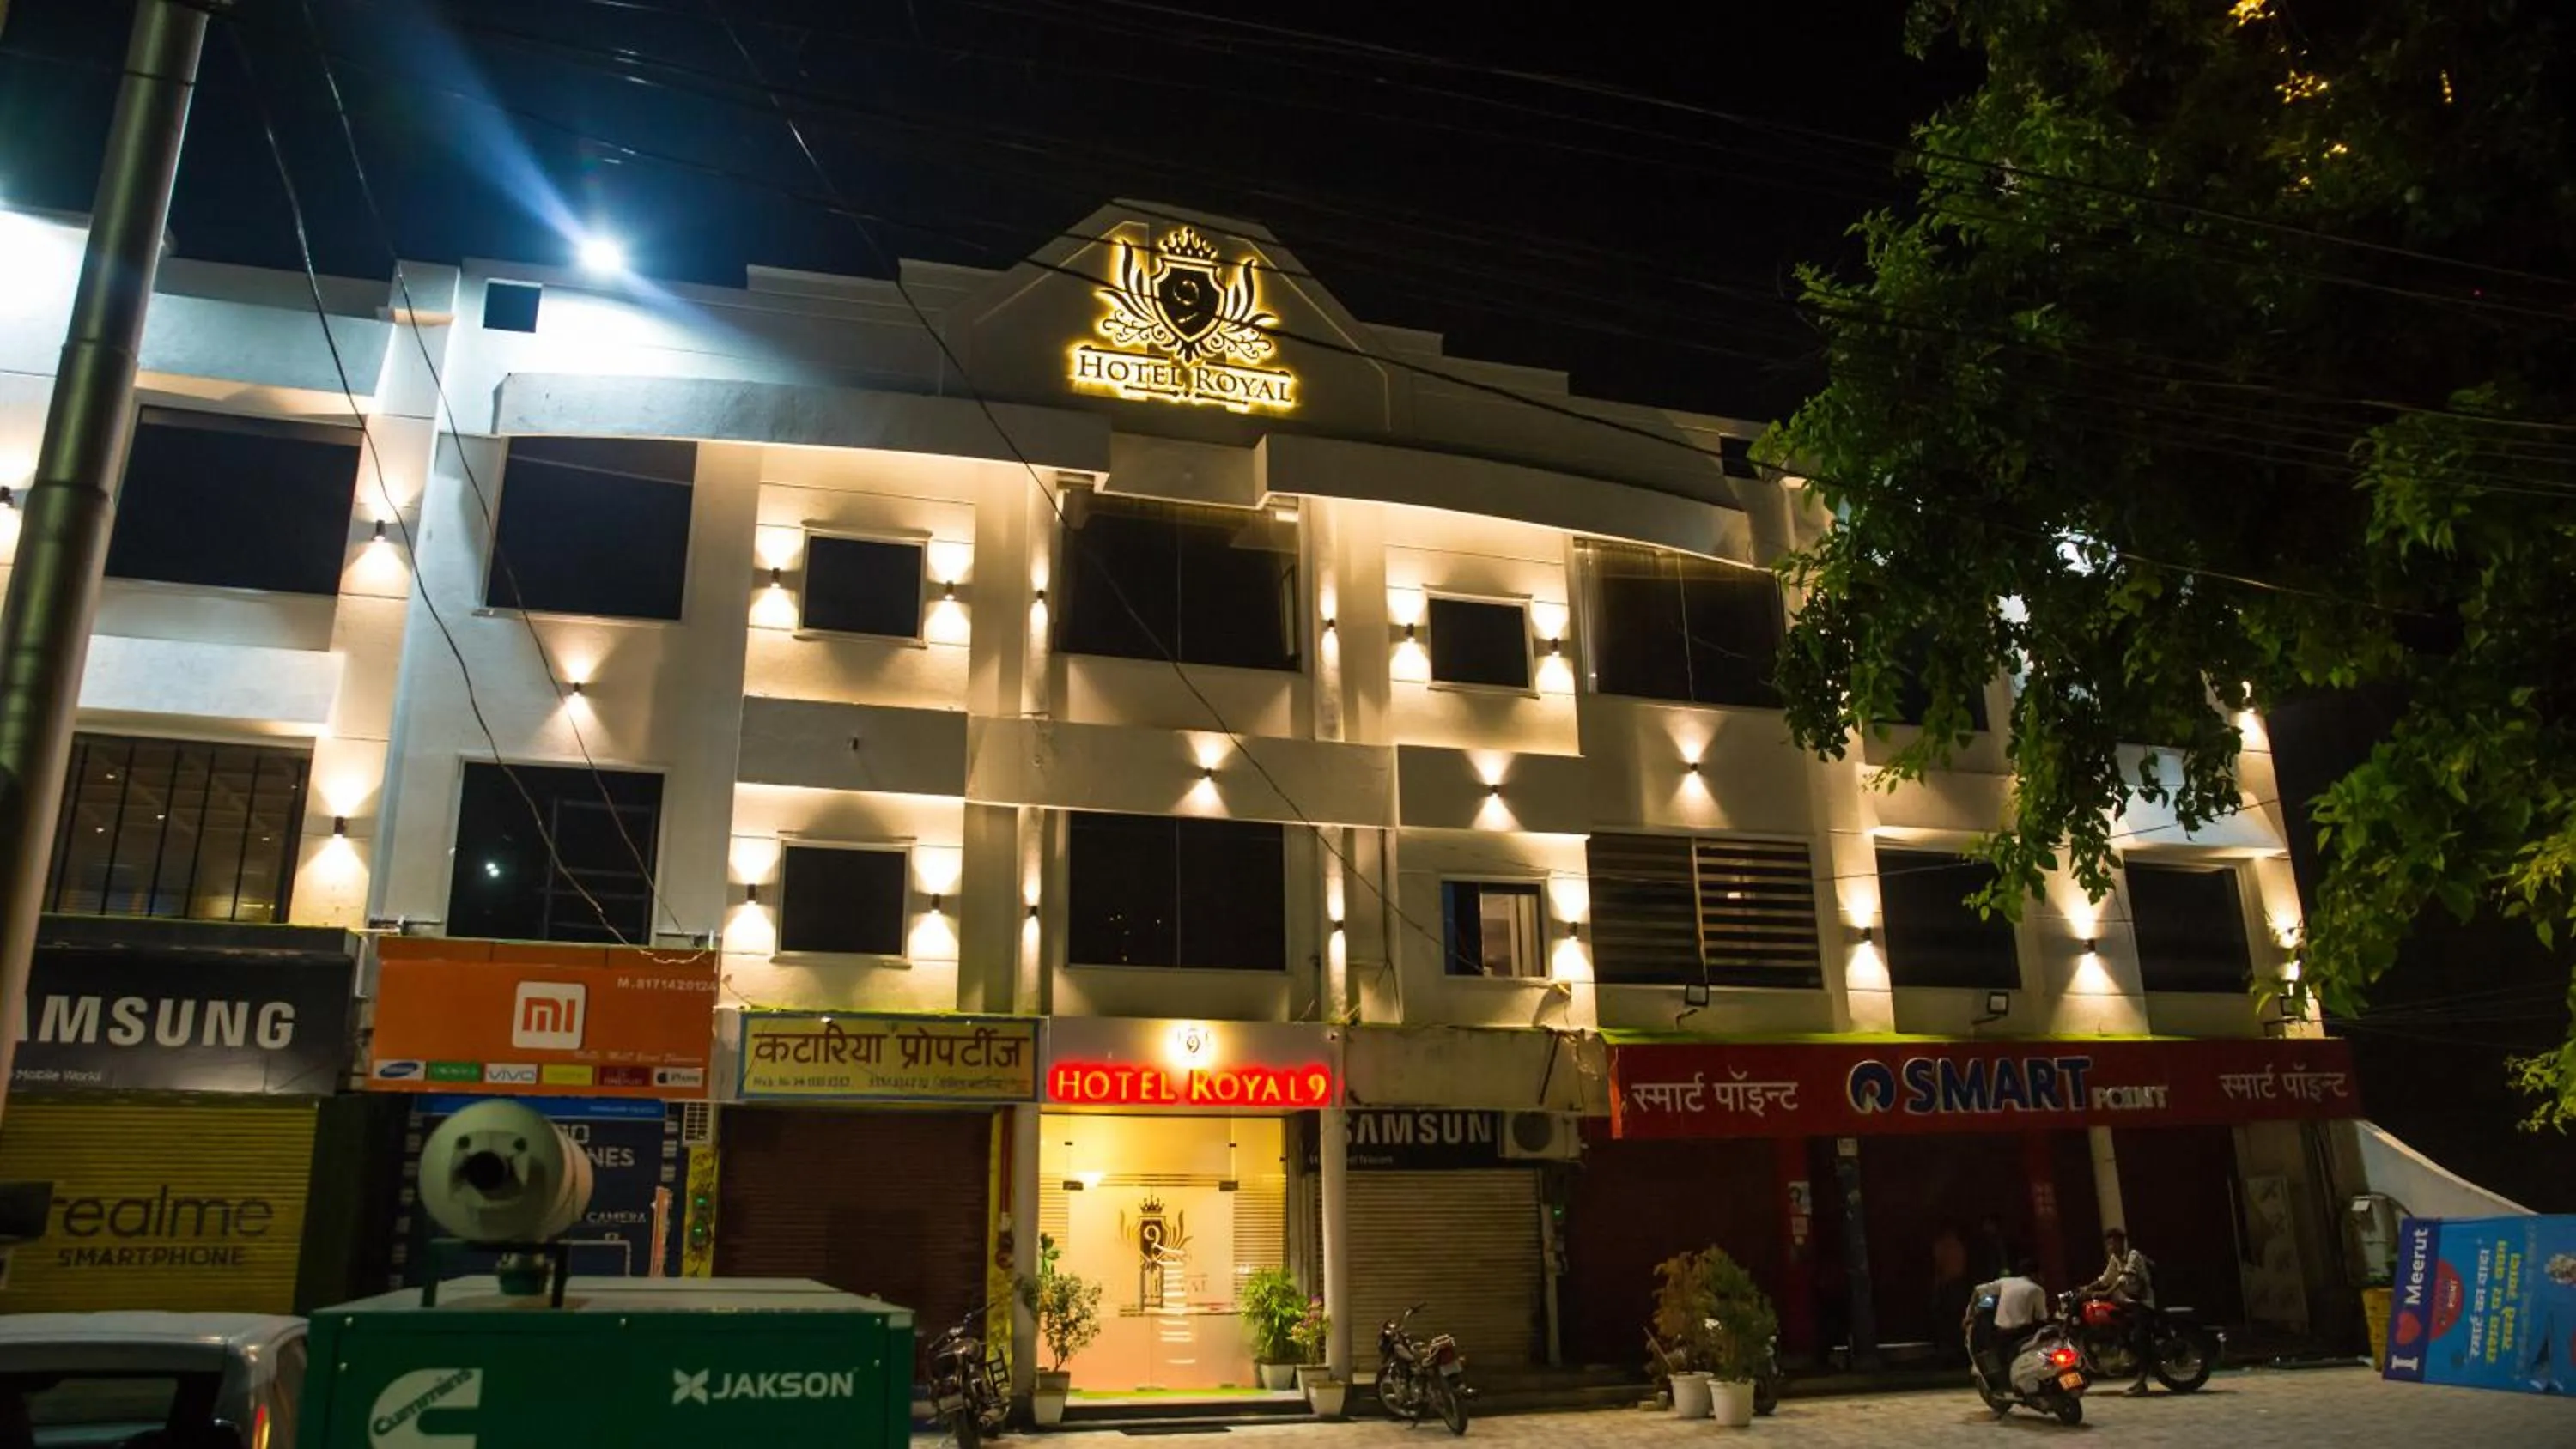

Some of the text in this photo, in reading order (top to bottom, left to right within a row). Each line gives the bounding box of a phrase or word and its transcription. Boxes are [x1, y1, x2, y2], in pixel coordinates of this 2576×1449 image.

[1078, 355, 1292, 402] HOTEL ROYAL
[752, 1022, 888, 1064] कटारिया
[1056, 1070, 1176, 1100] HOTEL
[1631, 1064, 1800, 1118] स्मार्ट पॉइन्ट
[1901, 1057, 2169, 1113] SMART POINT
[2218, 1061, 2350, 1103] स्मार्ट पॉइन्ट
[1346, 1113, 1493, 1145] AMSUN
[586, 1147, 635, 1168] NES
[586, 1211, 647, 1224] CAMERA
[58, 1246, 246, 1267] SMARTPHONE
[2391, 1228, 2429, 1371] I Meerut
[373, 1368, 475, 1437] Cummins
[712, 1371, 854, 1399] JAKSON
